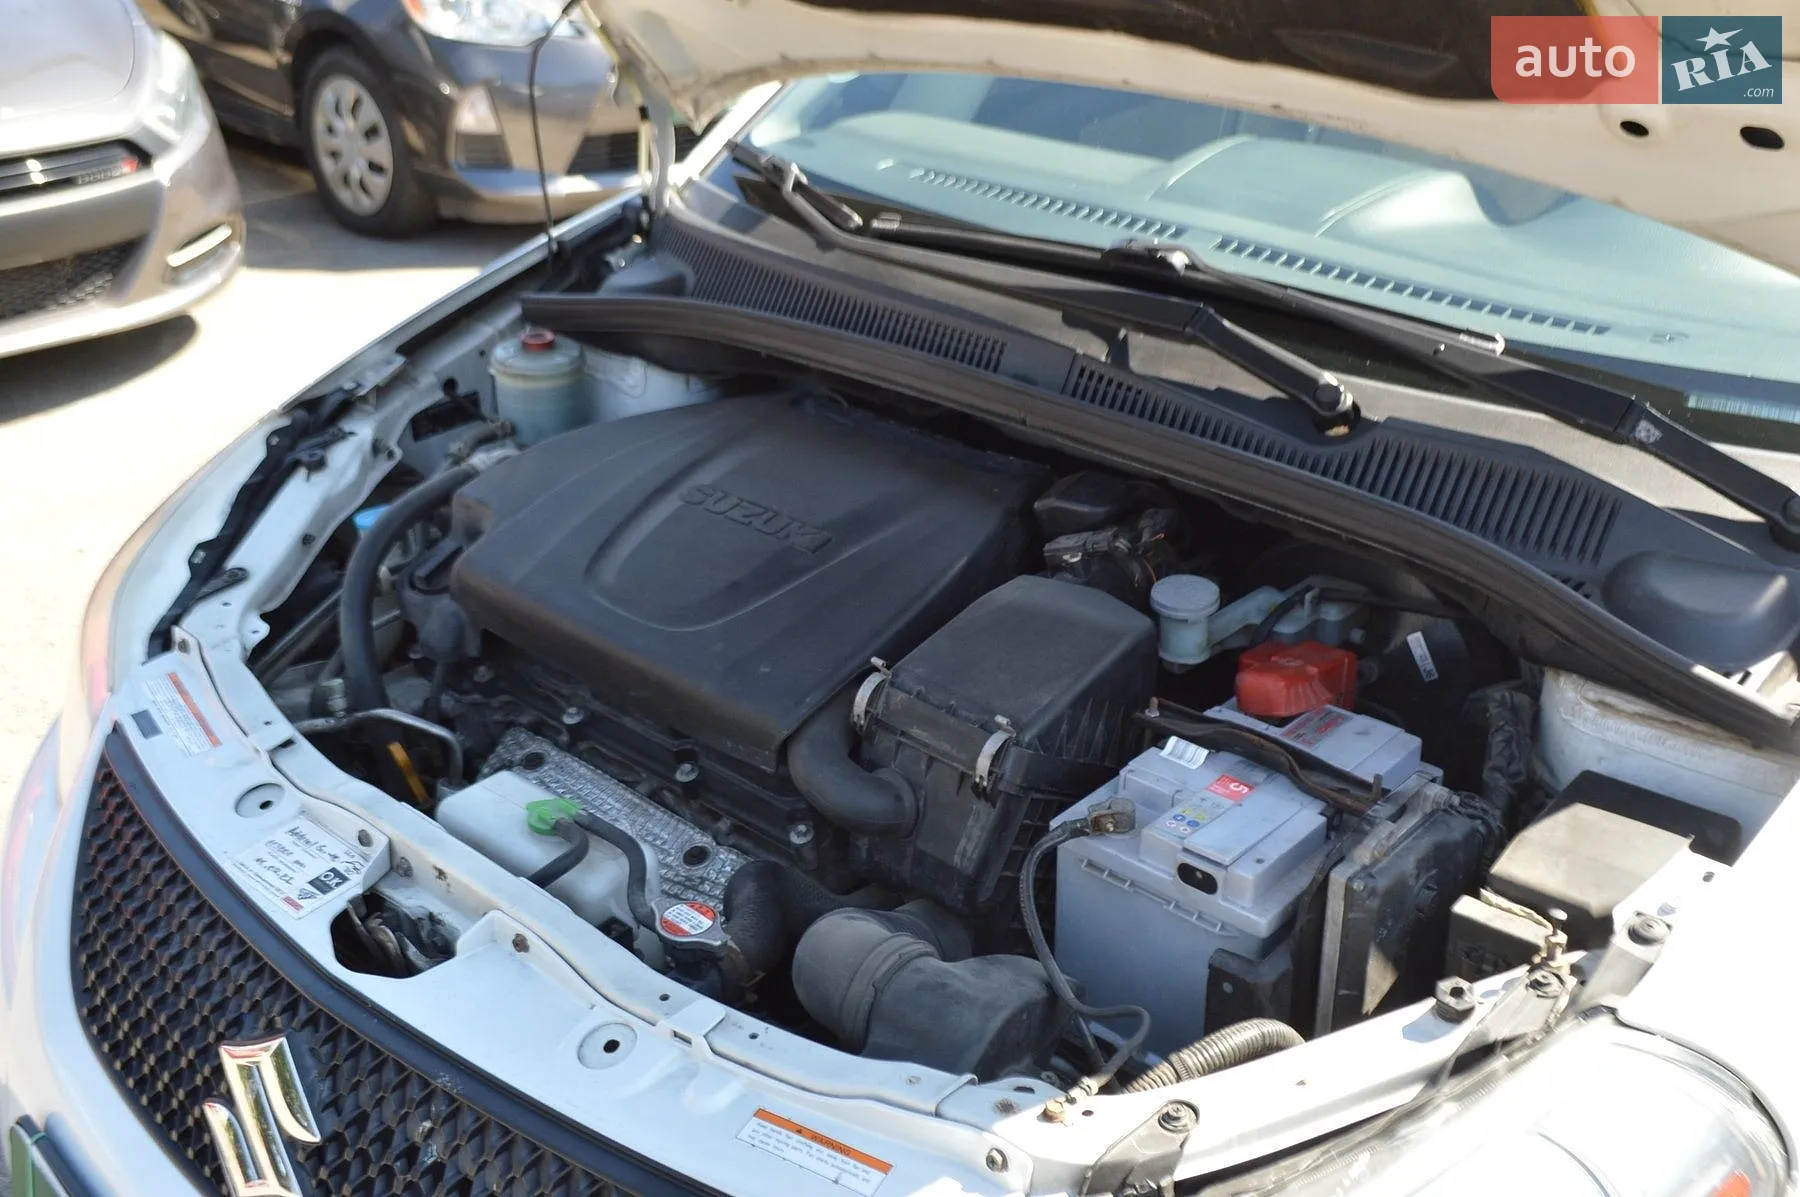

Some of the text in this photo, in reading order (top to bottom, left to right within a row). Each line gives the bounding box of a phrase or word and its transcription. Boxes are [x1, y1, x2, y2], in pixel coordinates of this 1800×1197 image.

[680, 484, 833, 554] SUZUKI
[320, 871, 343, 889] OK
[810, 1134, 853, 1158] WARNING
